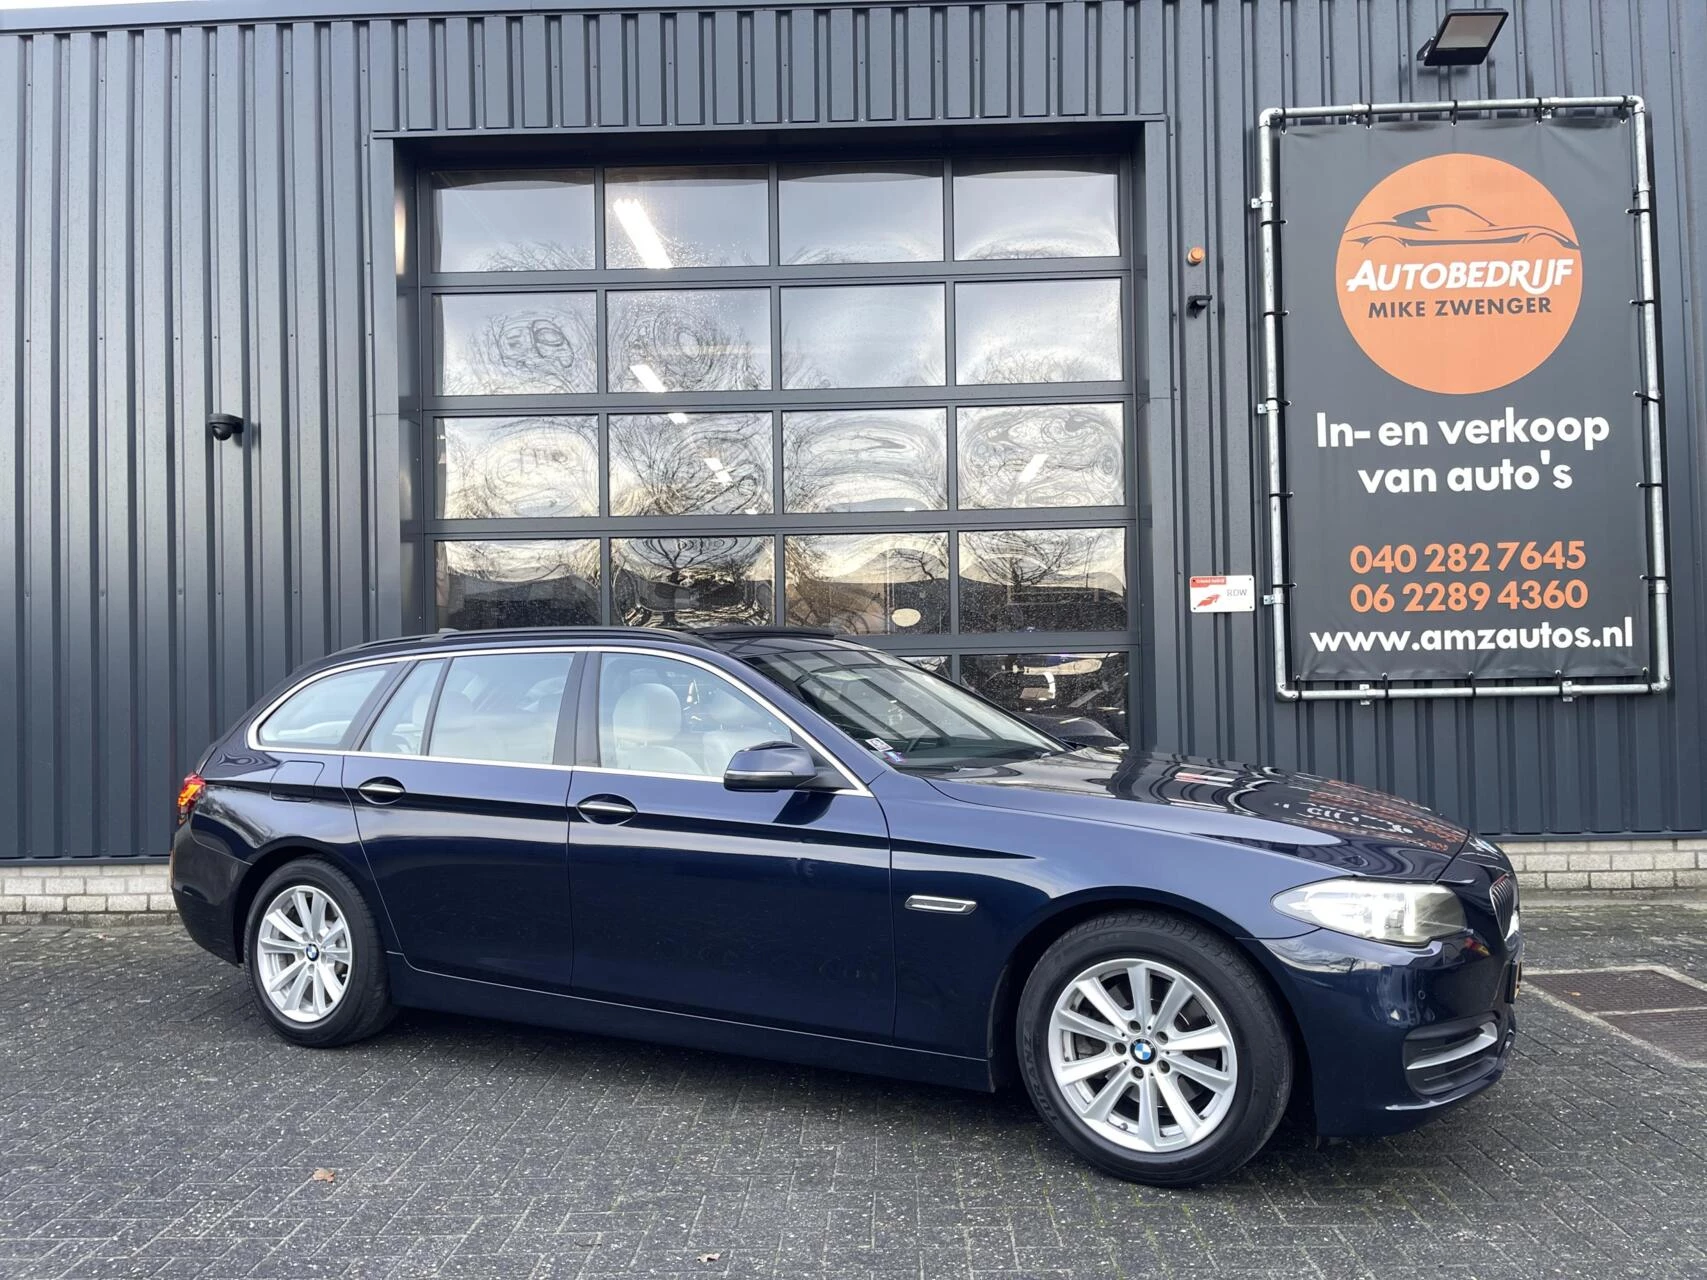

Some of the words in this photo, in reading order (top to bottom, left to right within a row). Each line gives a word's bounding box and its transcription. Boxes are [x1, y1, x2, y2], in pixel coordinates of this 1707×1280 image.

[1346, 259, 1575, 296] AUTOBEDRIJF
[1368, 301, 1425, 318] MIKE
[1436, 297, 1551, 317] ZWENGER
[1317, 413, 1371, 448] In-
[1379, 421, 1429, 447] en
[1438, 407, 1610, 450] verkoop
[1358, 468, 1437, 494] van
[1447, 450, 1573, 492] auto's
[1350, 545, 1416, 574] 040
[1424, 543, 1490, 573] 282
[1498, 541, 1586, 571] 7645
[1350, 584, 1395, 613] 06
[1403, 582, 1491, 612] 2289
[1498, 580, 1589, 609] 4360
[1310, 617, 1633, 652] www.amzautos.nl
[1024, 1019, 1059, 1122] TURANZ
